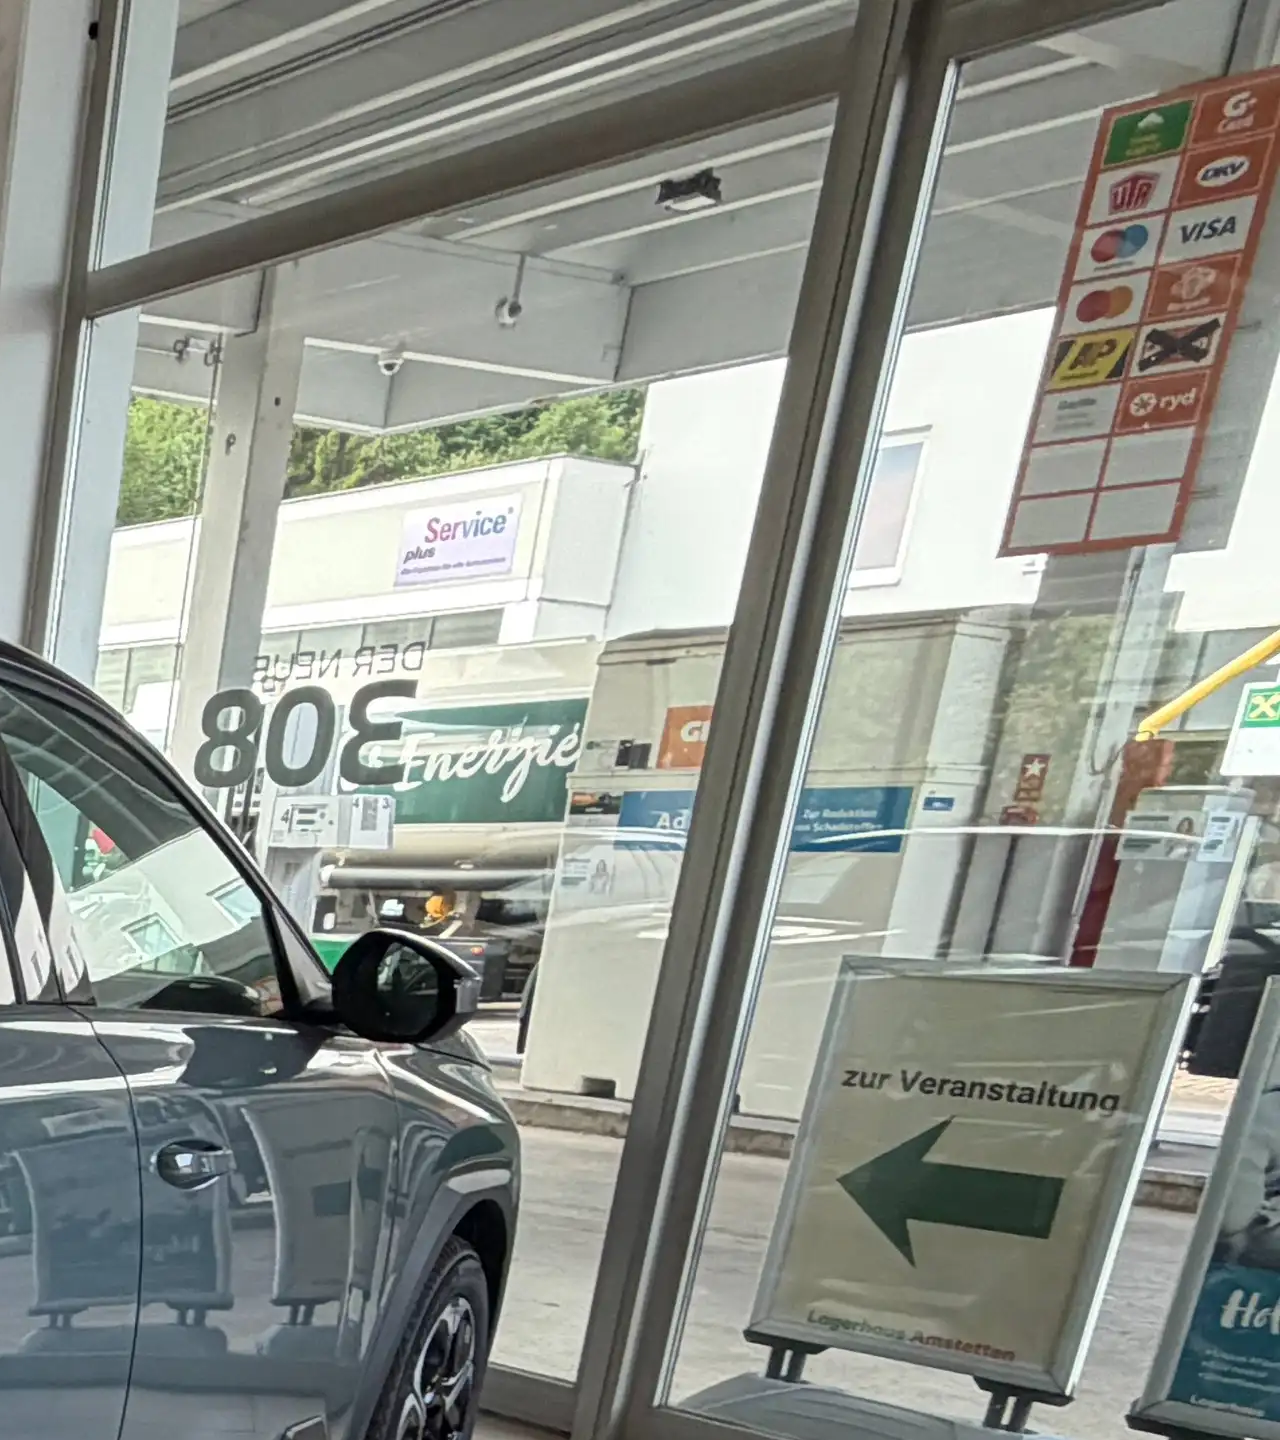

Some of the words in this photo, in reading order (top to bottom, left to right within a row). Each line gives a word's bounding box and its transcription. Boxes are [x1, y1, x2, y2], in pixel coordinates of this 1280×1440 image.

[1180, 216, 1237, 245] VISA
[1159, 388, 1198, 412] ryd
[424, 510, 507, 543] Service
[403, 546, 436, 564] plus
[841, 1069, 893, 1090] zur
[900, 1069, 1121, 1117] Veranstaltung
[807, 1309, 906, 1341] Lagerhaus
[910, 1329, 1017, 1362] Amstetten
